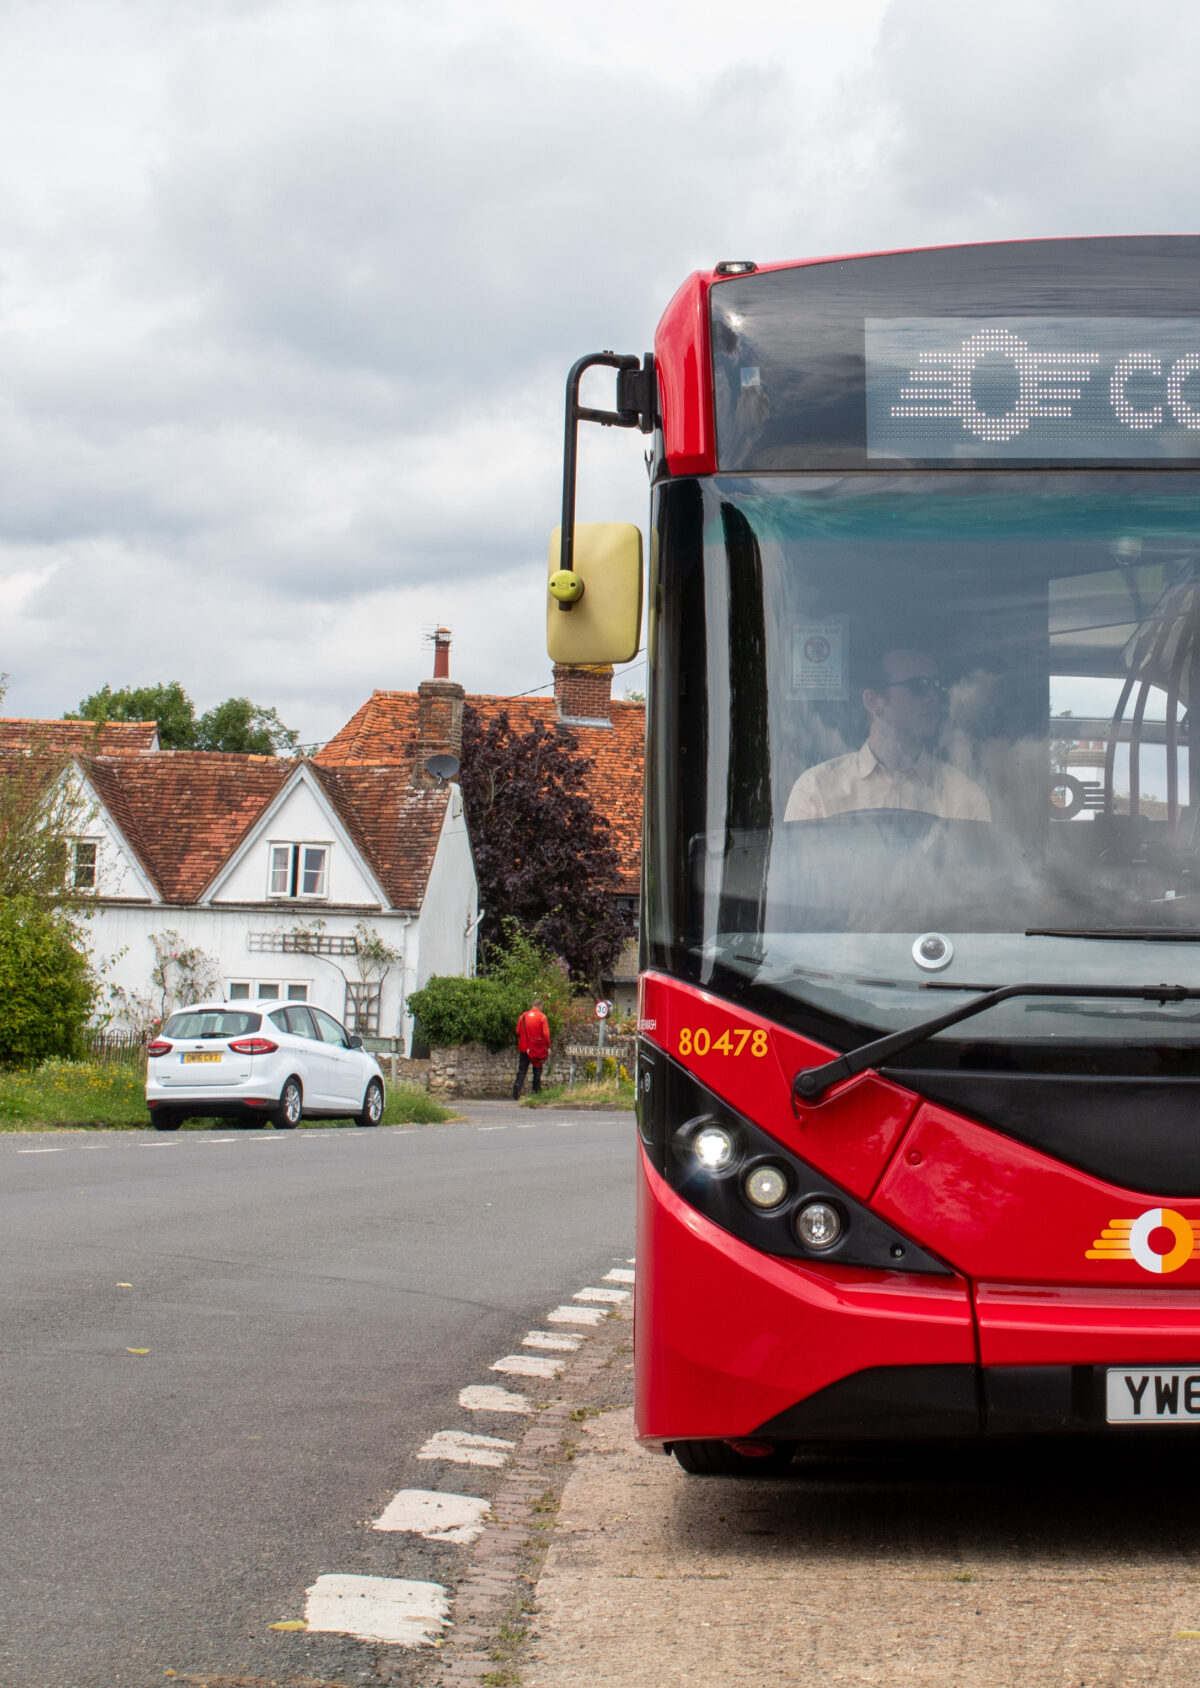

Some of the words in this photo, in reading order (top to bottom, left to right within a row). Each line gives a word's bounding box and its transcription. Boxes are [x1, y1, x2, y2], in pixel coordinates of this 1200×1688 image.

[597, 1005, 607, 1014] 30
[678, 1027, 768, 1058] 80478
[568, 1046, 594, 1055] SILVER
[596, 1047, 625, 1057] STREET
